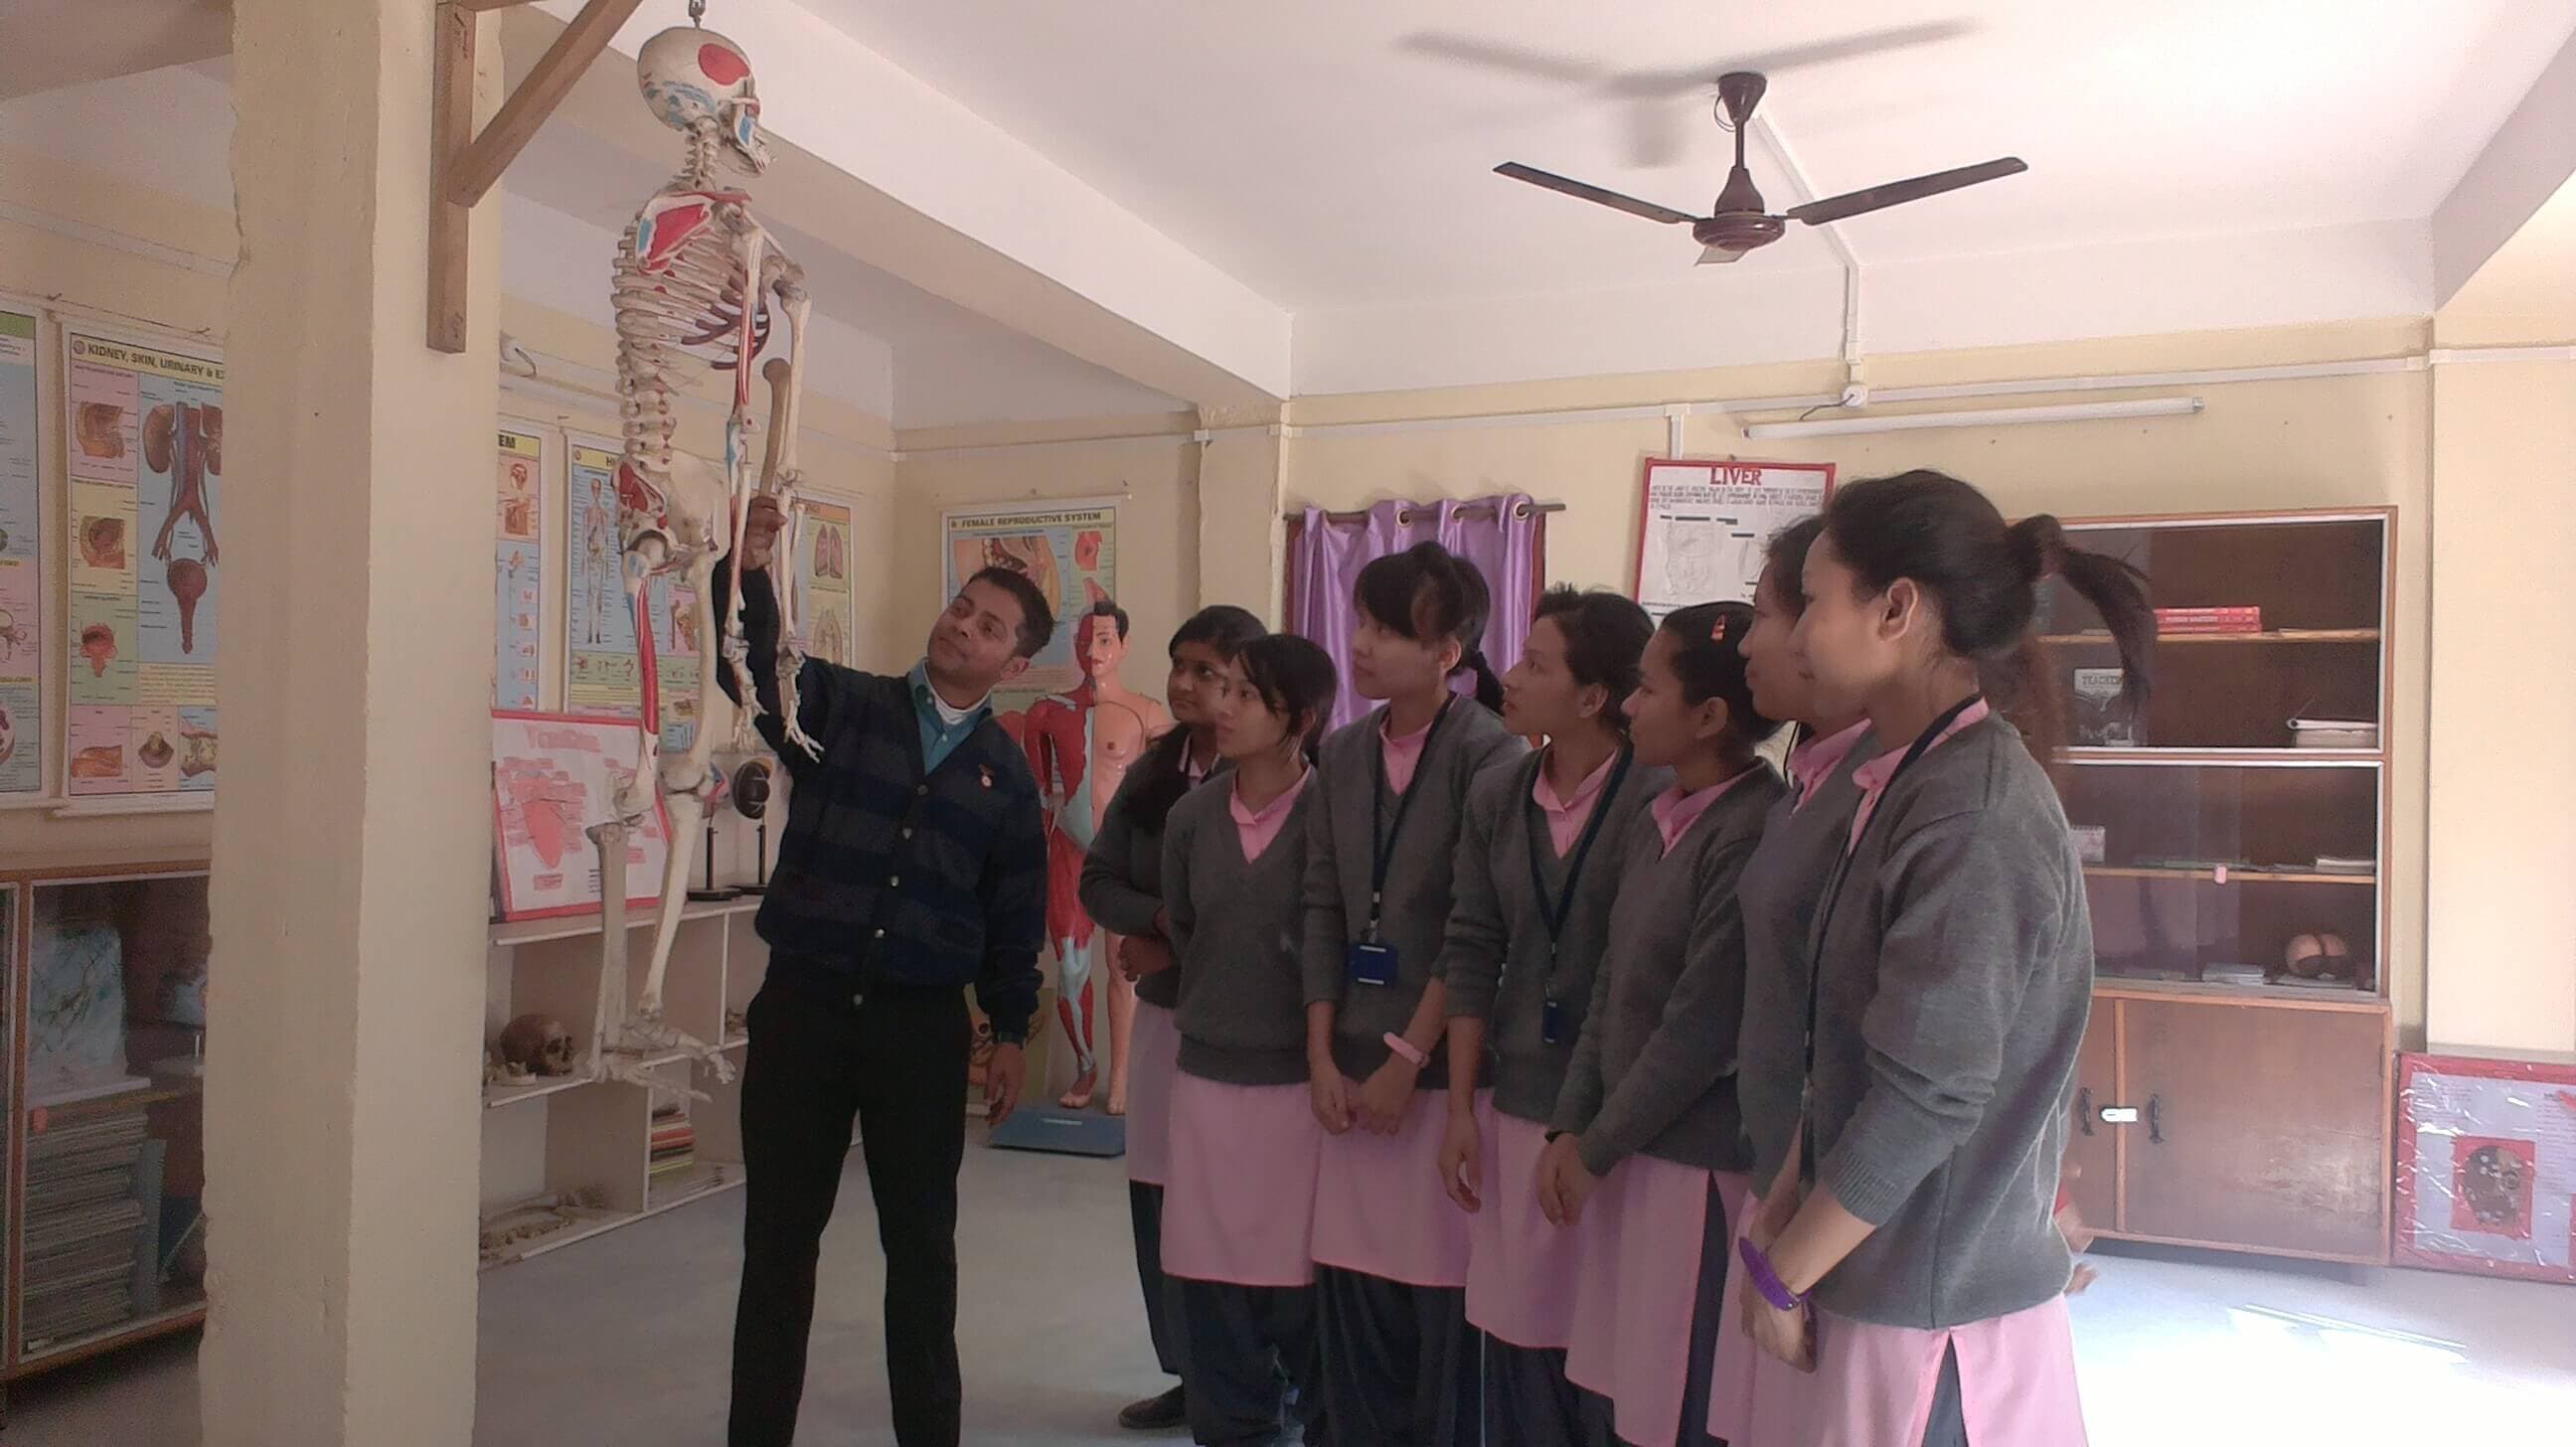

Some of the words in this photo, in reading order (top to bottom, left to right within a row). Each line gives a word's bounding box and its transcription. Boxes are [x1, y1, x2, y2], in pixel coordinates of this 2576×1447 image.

[87, 344, 129, 363] KIDNEY,
[131, 353, 158, 369] SKIN,
[161, 359, 204, 376] URINARY
[1709, 467, 1762, 485] LIVER
[962, 518, 995, 528] FEMALE
[997, 514, 1061, 526] REPRODUCTIVE
[1065, 512, 1101, 522] SYSTEM
